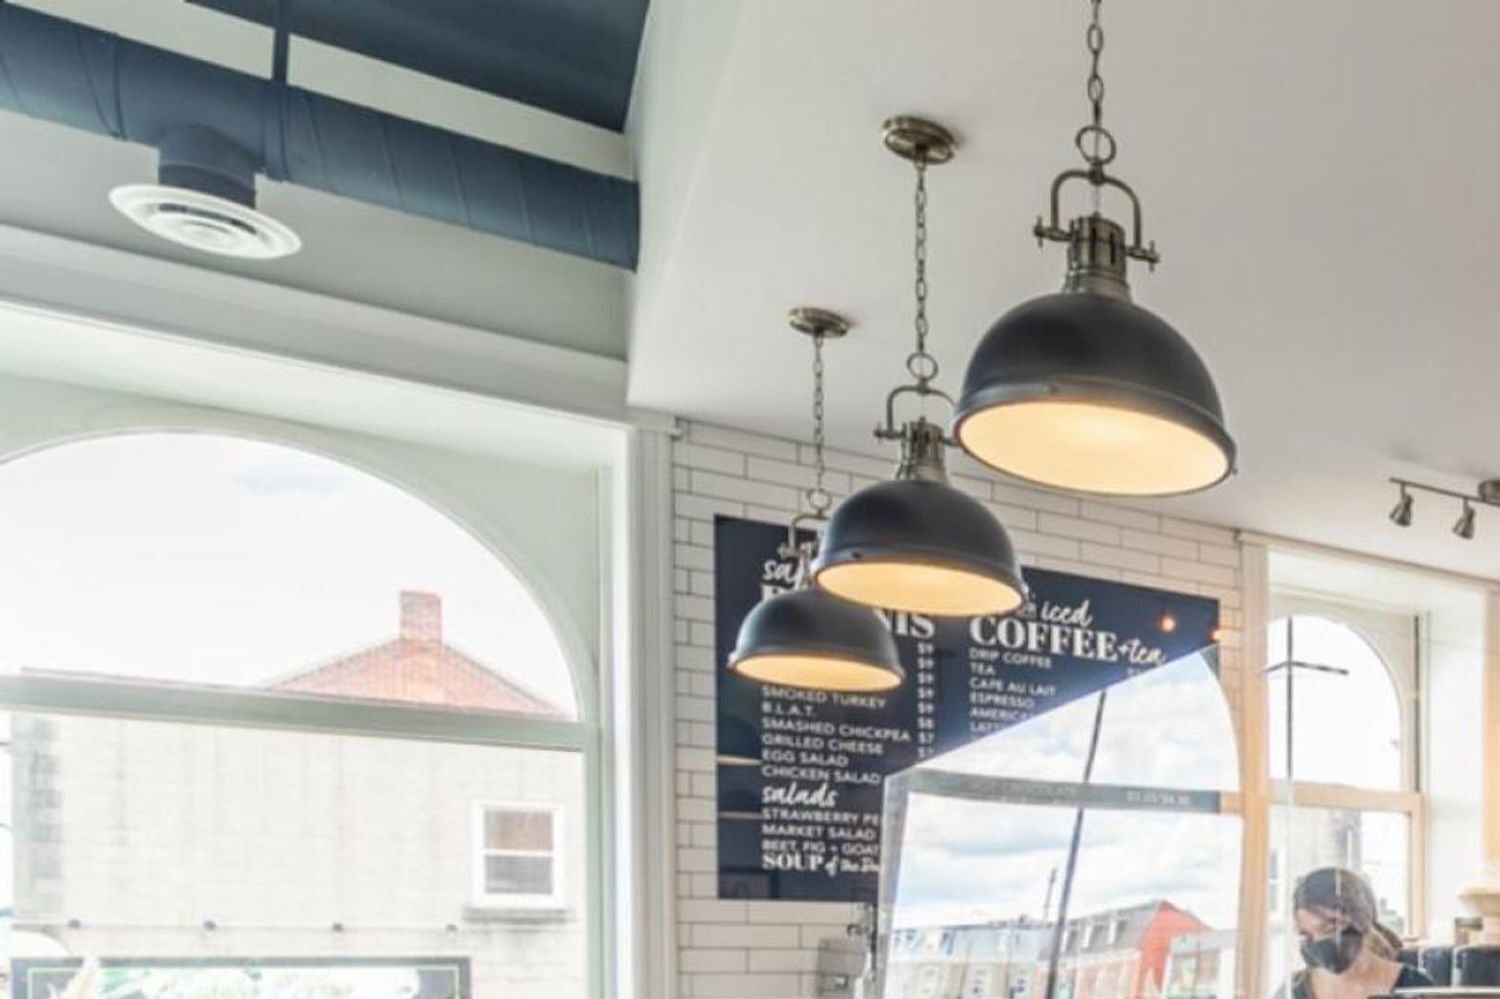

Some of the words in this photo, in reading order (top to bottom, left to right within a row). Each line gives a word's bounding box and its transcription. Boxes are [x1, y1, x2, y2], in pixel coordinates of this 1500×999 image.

[1041, 600, 1093, 627] iced
[969, 616, 1118, 662] COFFEE
[969, 648, 999, 660] DRIP
[1002, 651, 1053, 669] COFFEE
[970, 662, 996, 675] TEA
[969, 691, 1036, 709] ESPRESSO
[761, 716, 836, 736] SMASHED
[838, 724, 912, 743] CHICKPEA
[761, 732, 825, 750] GRILLED
[827, 738, 884, 756] CHEESE
[761, 749, 796, 763] EGG
[799, 752, 850, 768] SALAD
[761, 765, 830, 781] CHICKEN
[833, 771, 882, 785] SALAD
[761, 781, 840, 808] salads
[761, 807, 858, 825] STRAWBERRY
[761, 824, 825, 838] MARKET
[827, 827, 877, 842] SALAD
[761, 853, 824, 872] SOUP
